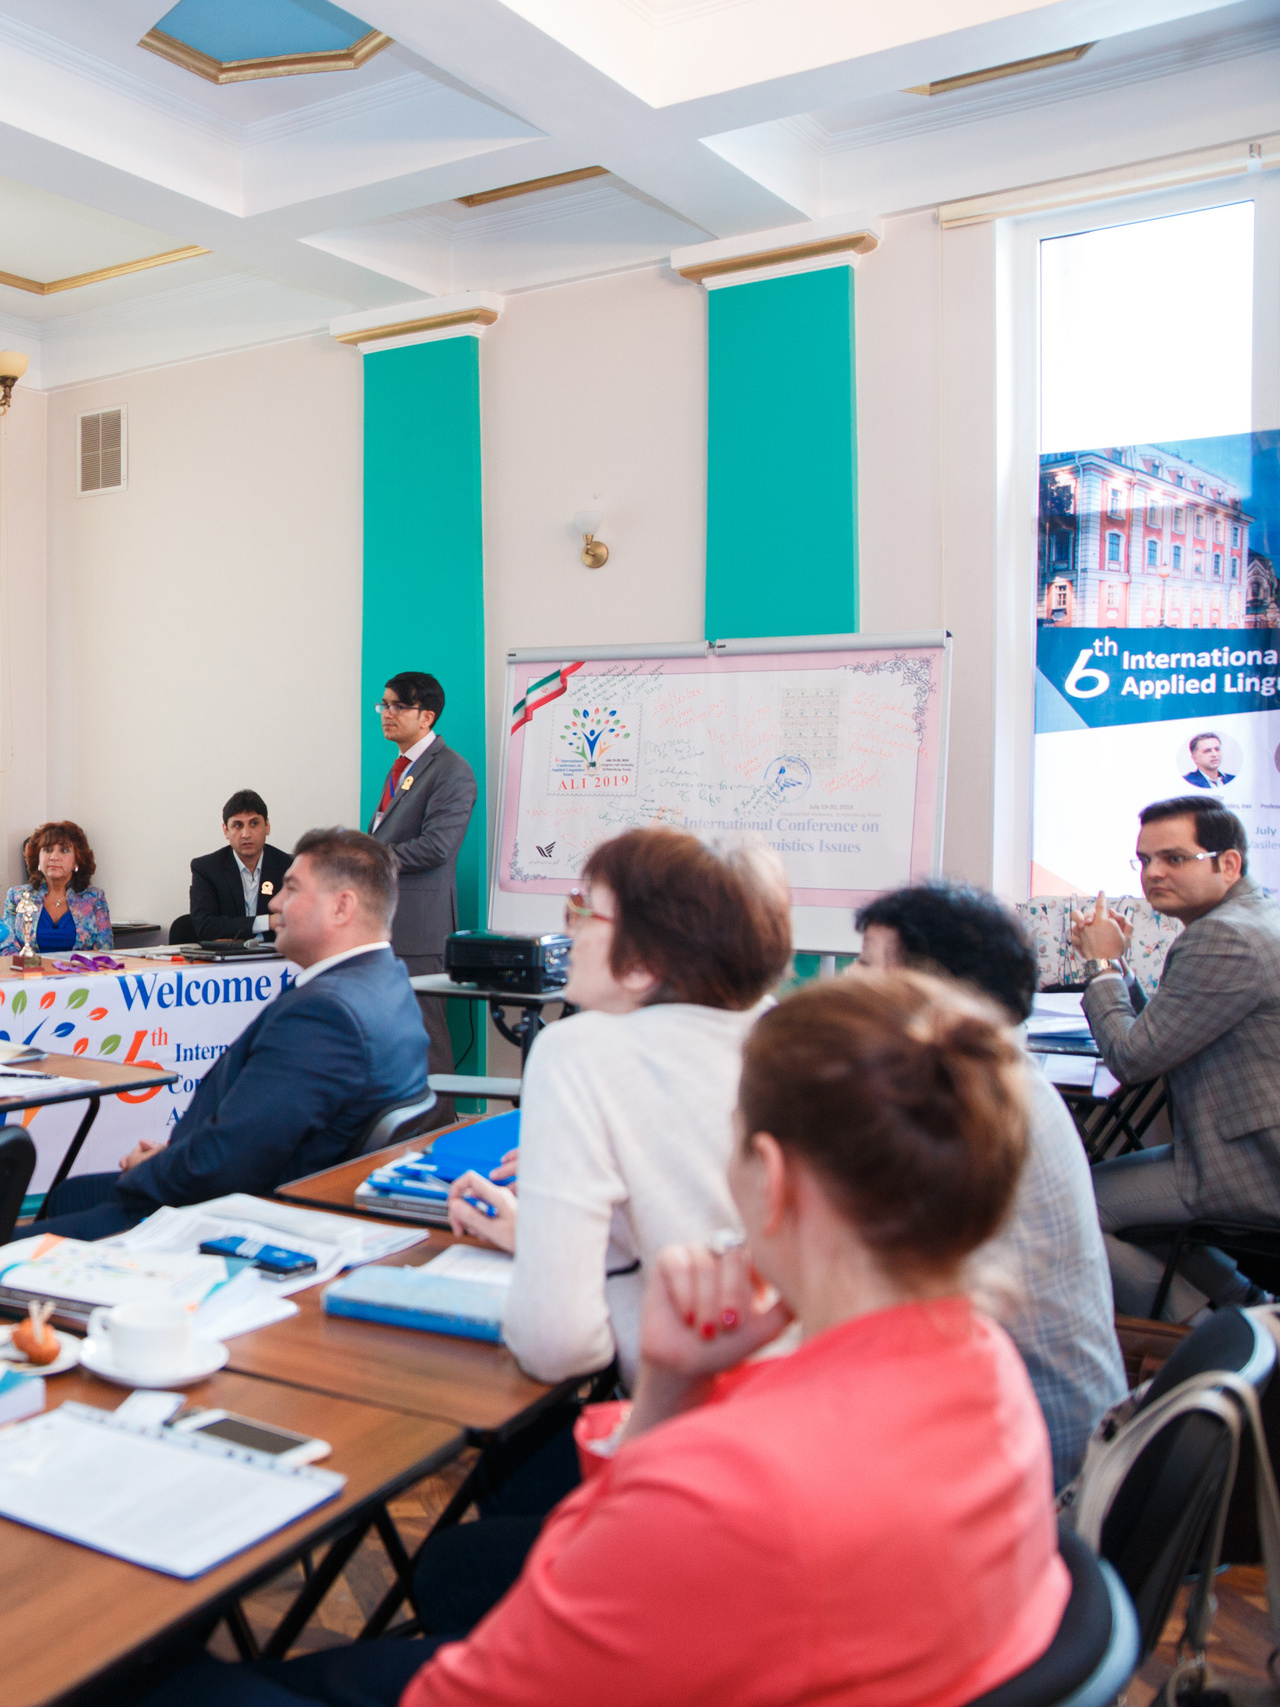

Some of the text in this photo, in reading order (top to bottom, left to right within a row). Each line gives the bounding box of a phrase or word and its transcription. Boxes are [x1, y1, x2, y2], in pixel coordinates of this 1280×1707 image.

[1121, 673, 1280, 700] Applied Ling
[558, 775, 629, 791] ALI 2019
[684, 816, 773, 831] International
[777, 818, 858, 832] Conference
[862, 822, 880, 832] on
[1255, 826, 1277, 837] July
[819, 838, 862, 853] Issues
[115, 971, 272, 1012] Welcome
